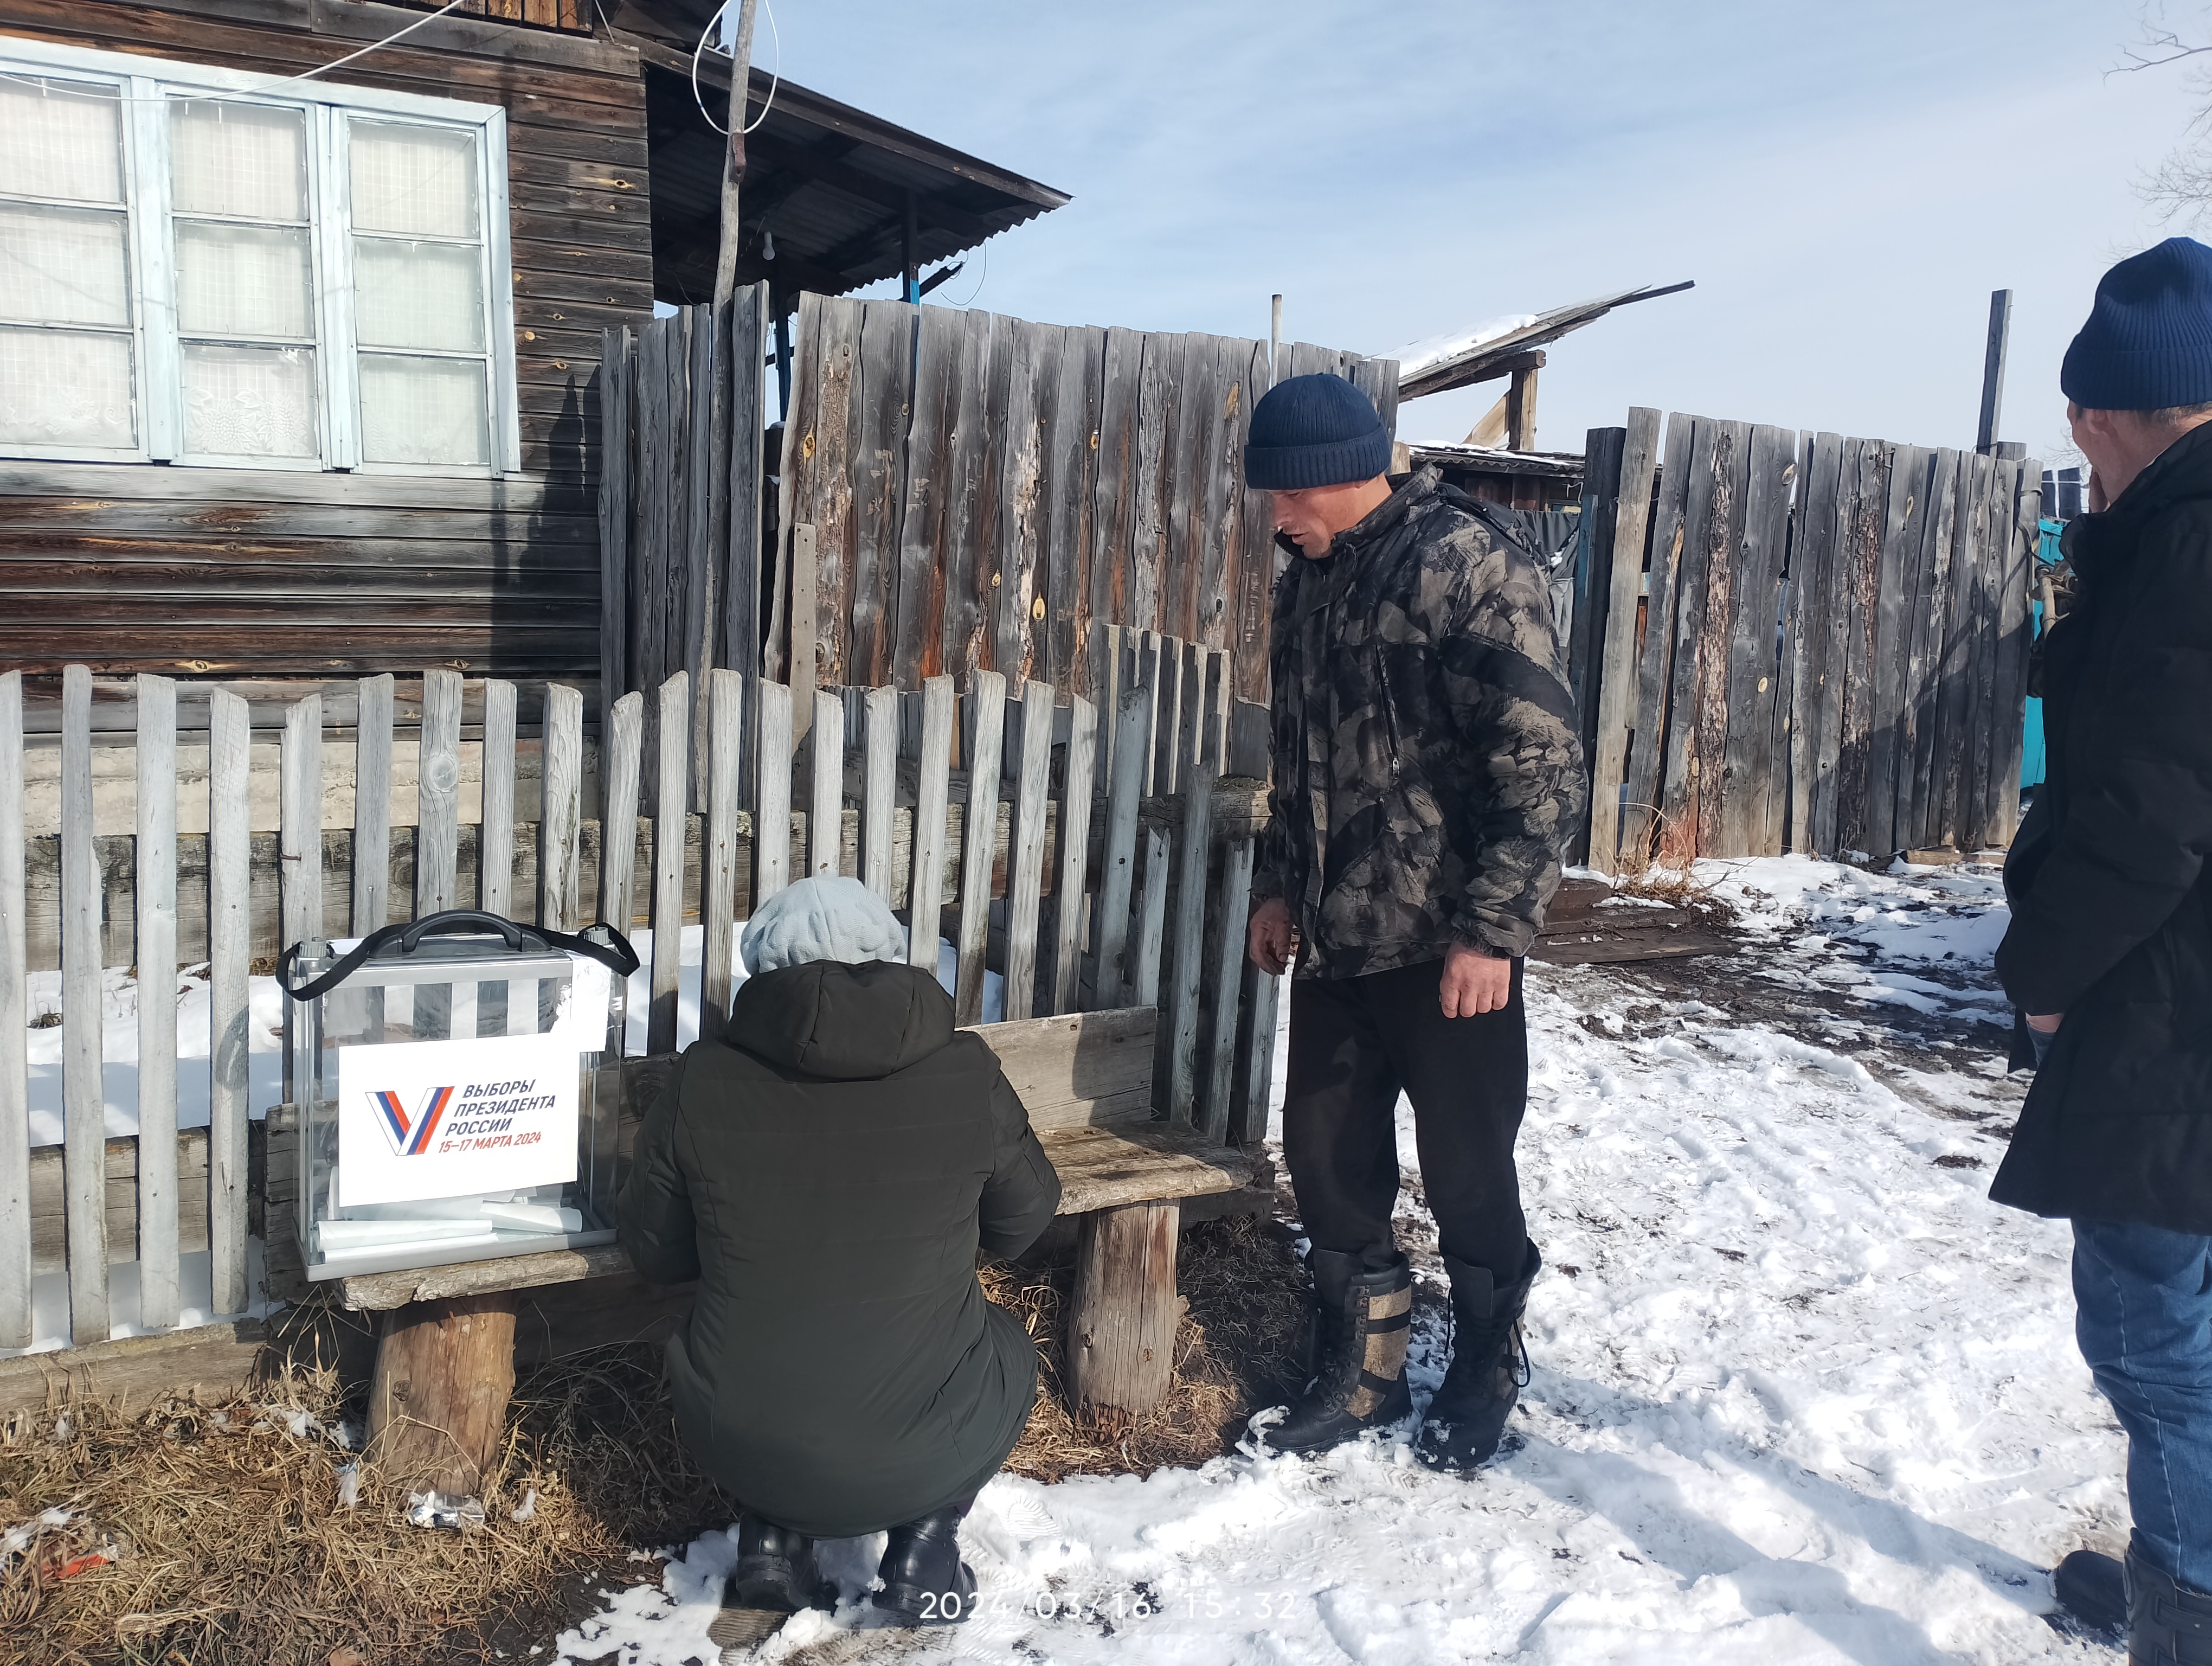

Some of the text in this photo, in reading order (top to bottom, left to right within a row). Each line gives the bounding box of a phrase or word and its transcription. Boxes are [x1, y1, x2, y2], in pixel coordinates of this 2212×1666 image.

[462, 1079, 536, 1099] ВЫБОРЫ
[453, 1095, 556, 1118] ПРЕЗИДЕНТА
[445, 1117, 513, 1137] РОССИИ
[472, 1135, 513, 1150] МАРТА
[513, 1131, 542, 1146] 2024
